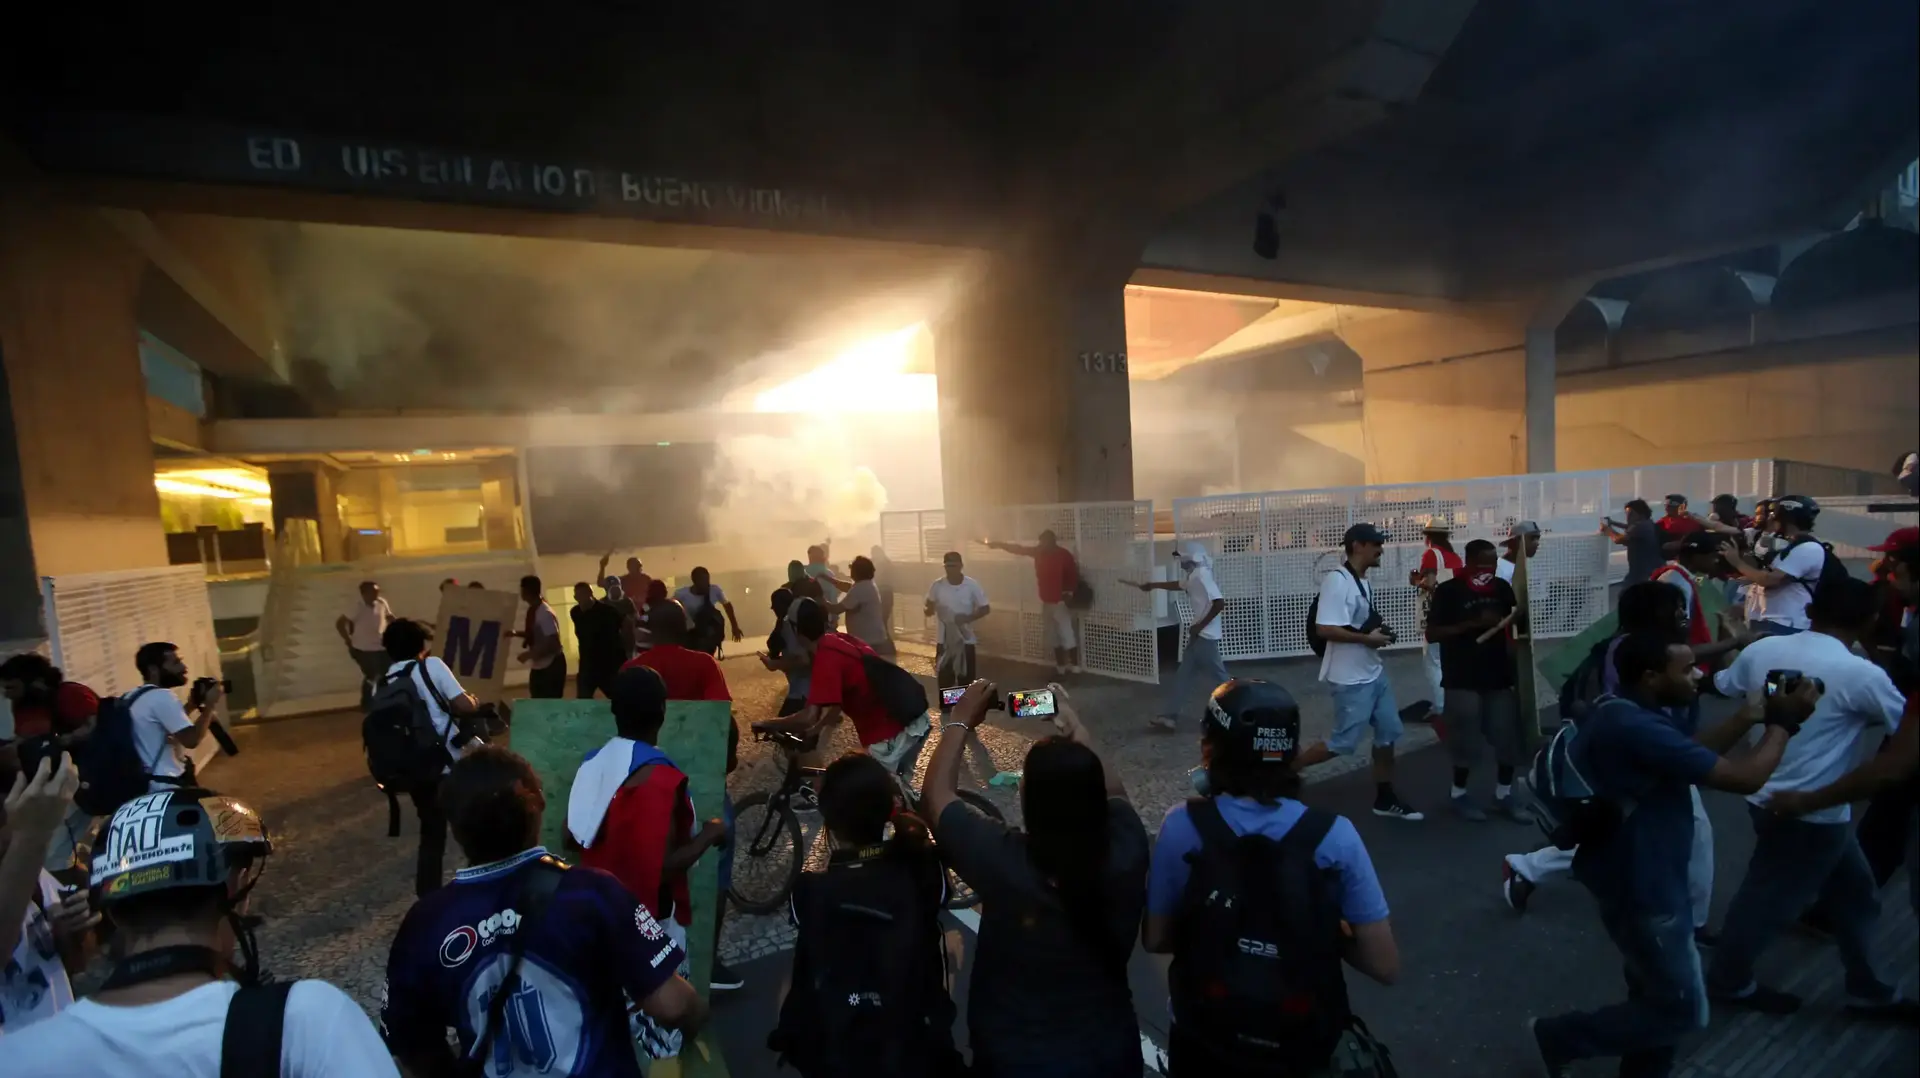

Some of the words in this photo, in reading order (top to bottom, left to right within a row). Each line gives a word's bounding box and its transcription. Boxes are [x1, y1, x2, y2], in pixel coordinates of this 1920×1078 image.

[1079, 351, 1126, 373] 1313
[443, 615, 502, 679] M
[1257, 727, 1287, 738] PRESS
[107, 814, 161, 863] NÃO
